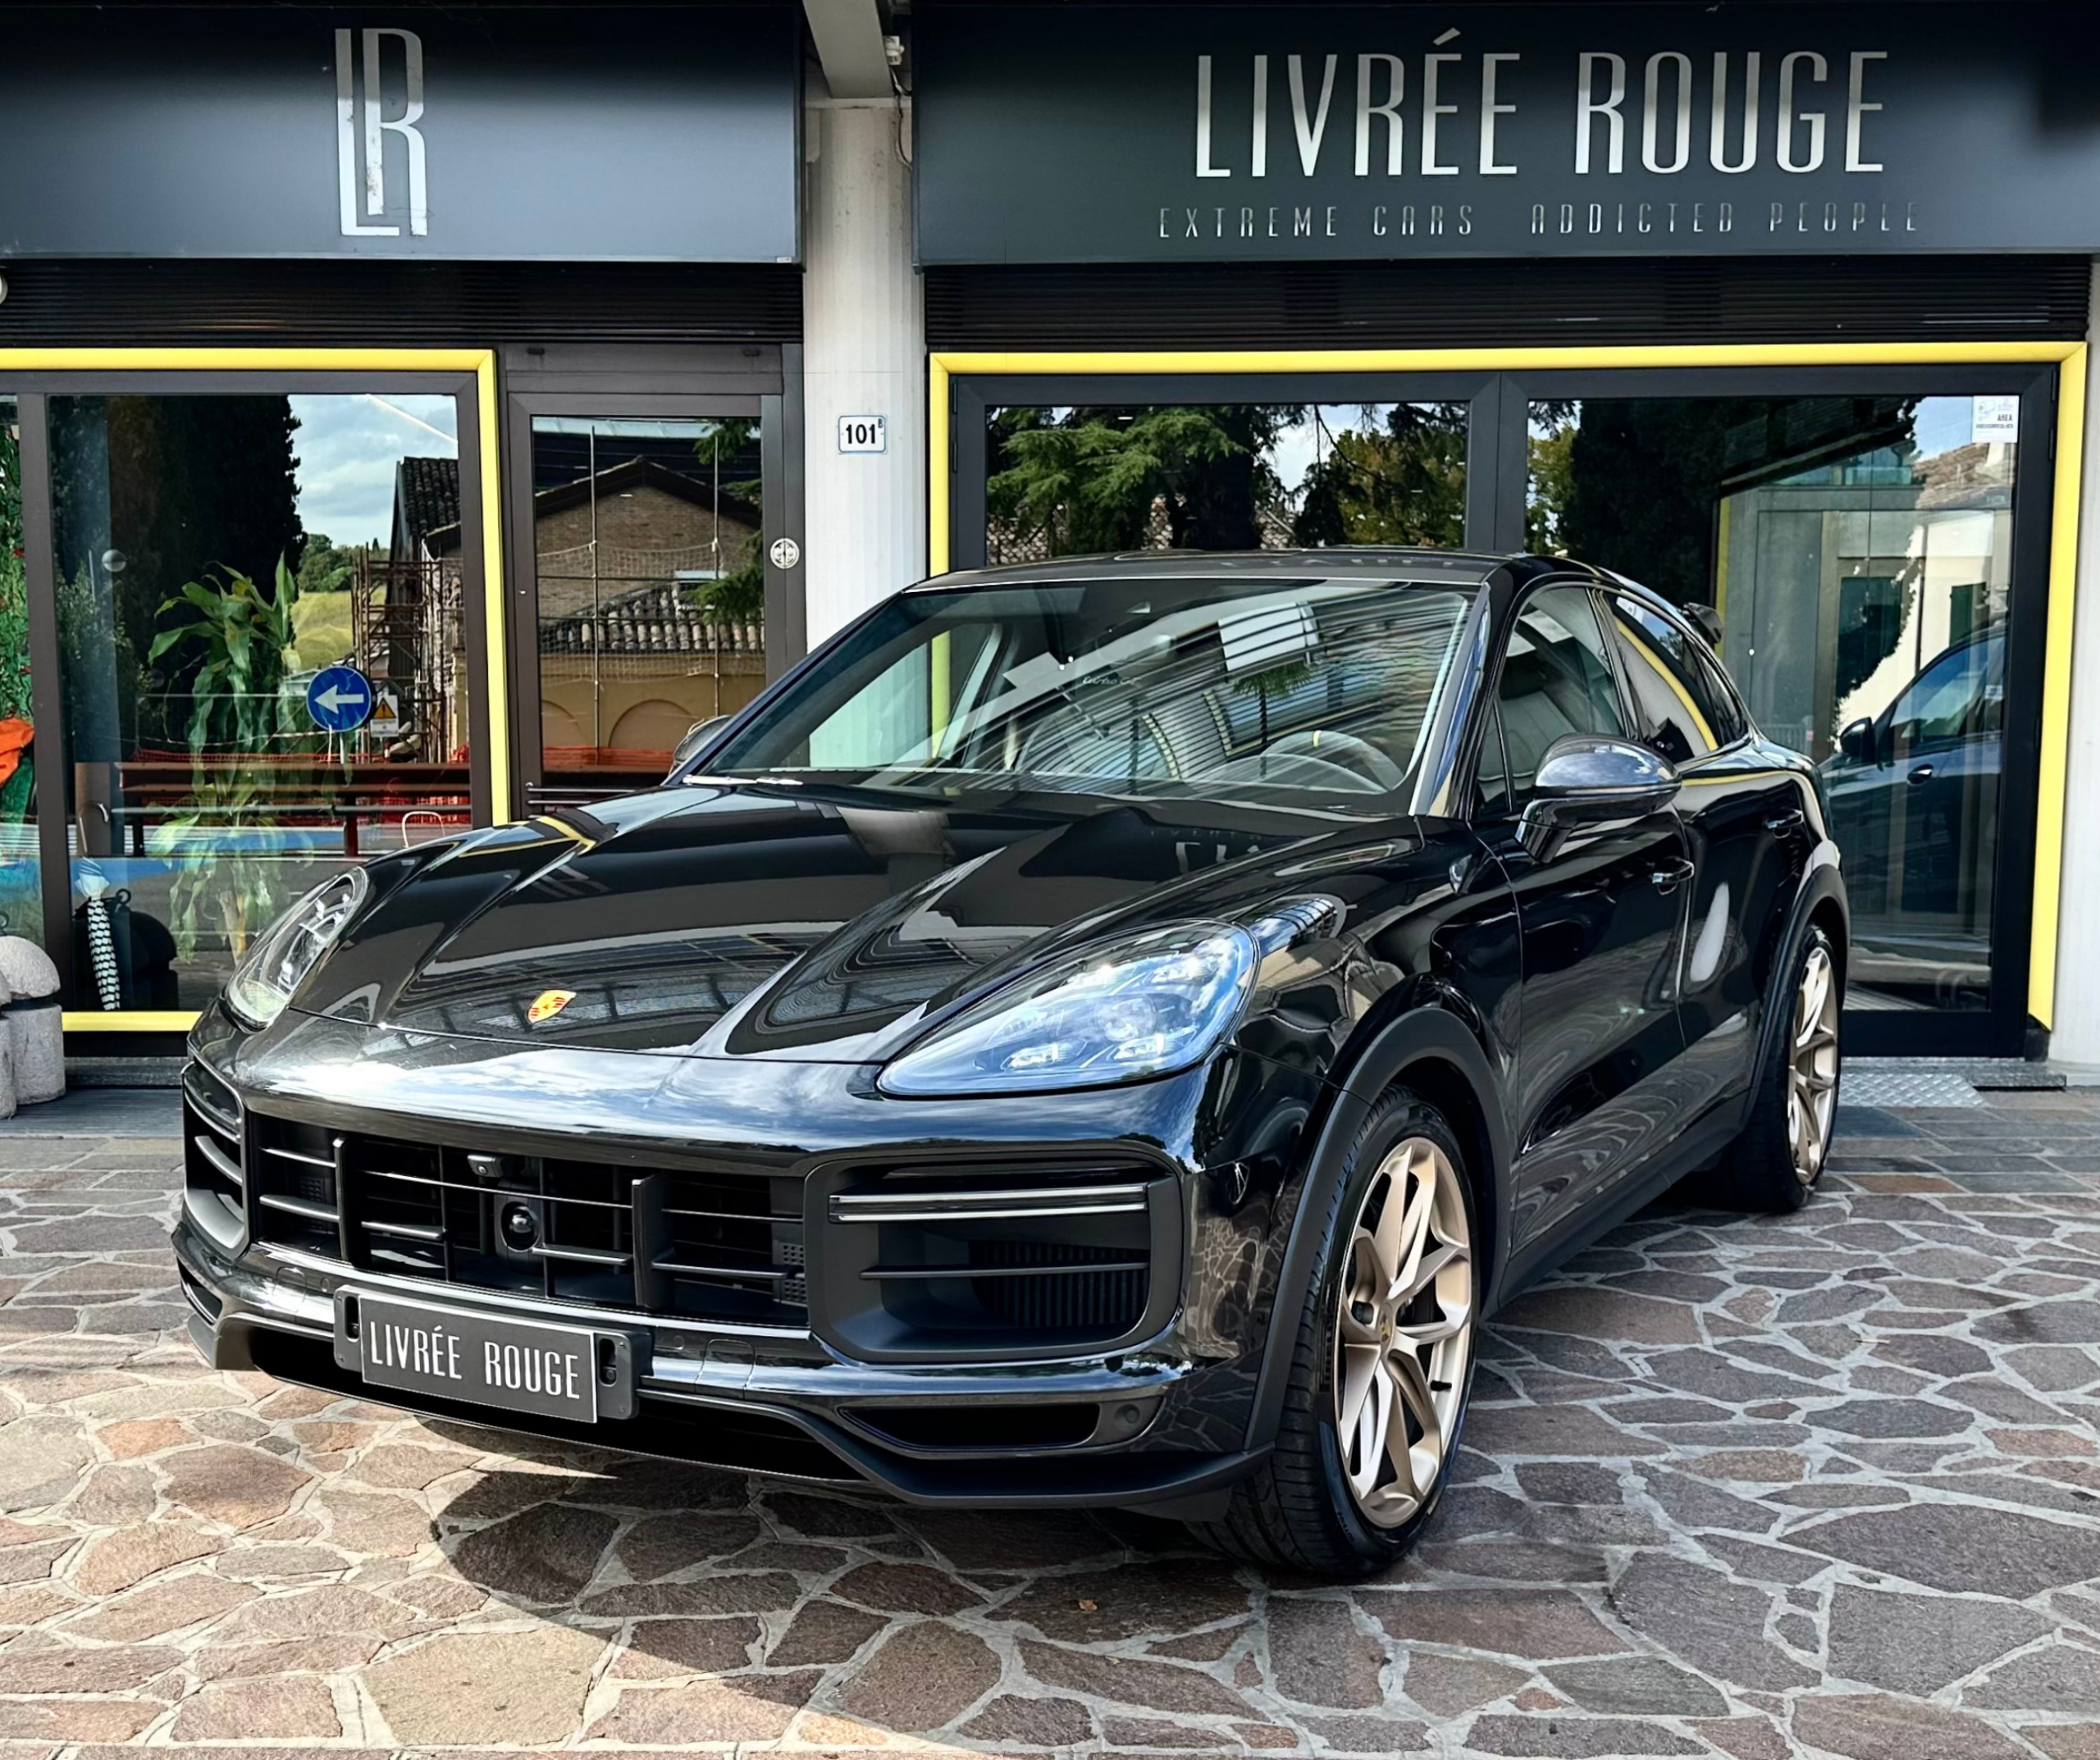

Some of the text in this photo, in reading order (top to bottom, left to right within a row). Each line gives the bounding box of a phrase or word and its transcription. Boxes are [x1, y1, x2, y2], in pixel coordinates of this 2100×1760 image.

[1195, 26, 1889, 178] LIVRÉE ROUGE
[1159, 201, 1918, 239] EXTREME CARS ADDICTED PEOPLE
[846, 424, 875, 444] 101
[369, 1320, 581, 1400] LIVRÉE ROUGE
